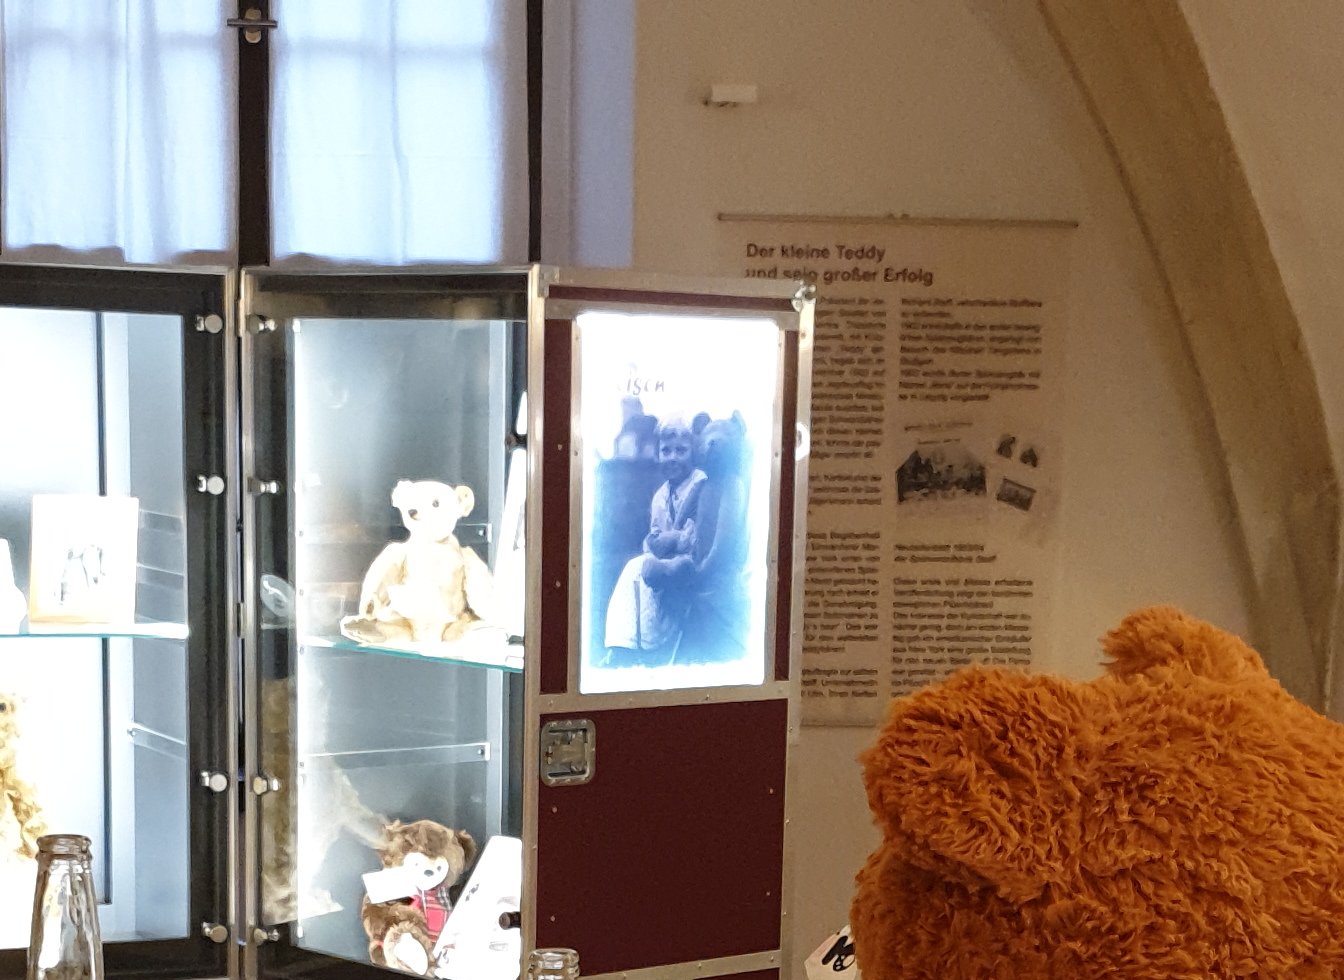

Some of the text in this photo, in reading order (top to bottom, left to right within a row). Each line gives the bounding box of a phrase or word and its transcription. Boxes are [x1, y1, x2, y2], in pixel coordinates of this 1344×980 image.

[746, 243, 887, 263] Der kleine Teddy
[745, 267, 778, 279] und
[823, 267, 878, 285] großer
[883, 267, 934, 287] Erfolg
